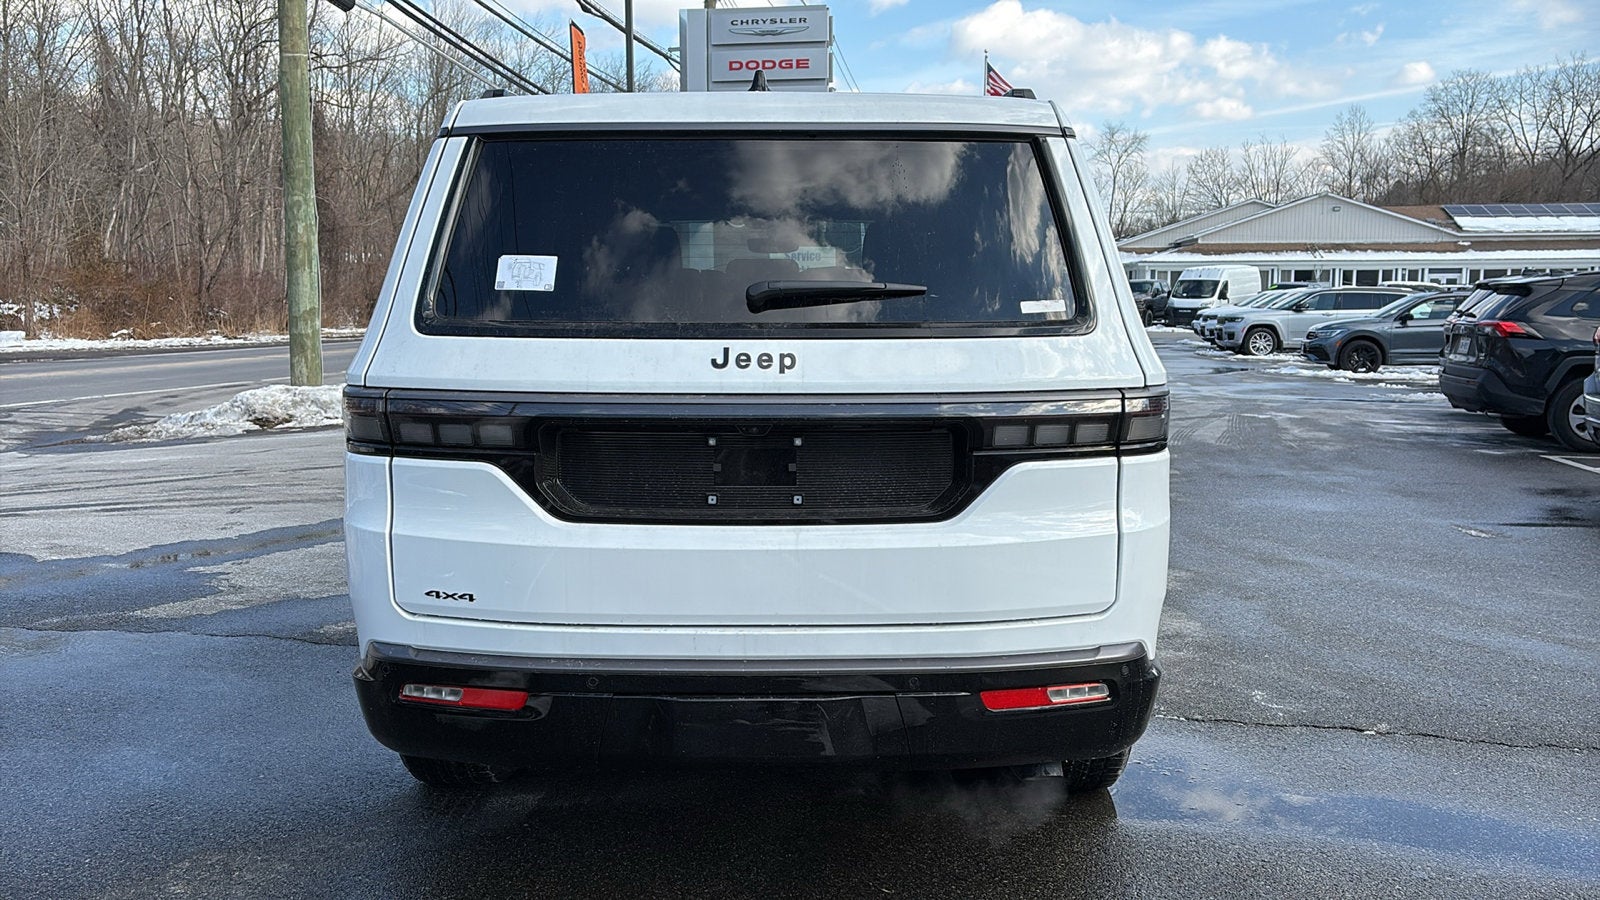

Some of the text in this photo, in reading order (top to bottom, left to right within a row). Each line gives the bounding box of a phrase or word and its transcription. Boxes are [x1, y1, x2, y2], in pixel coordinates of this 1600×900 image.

[730, 17, 808, 26] CHRYSLER
[728, 58, 810, 71] DODGE
[710, 346, 797, 375] Jeep
